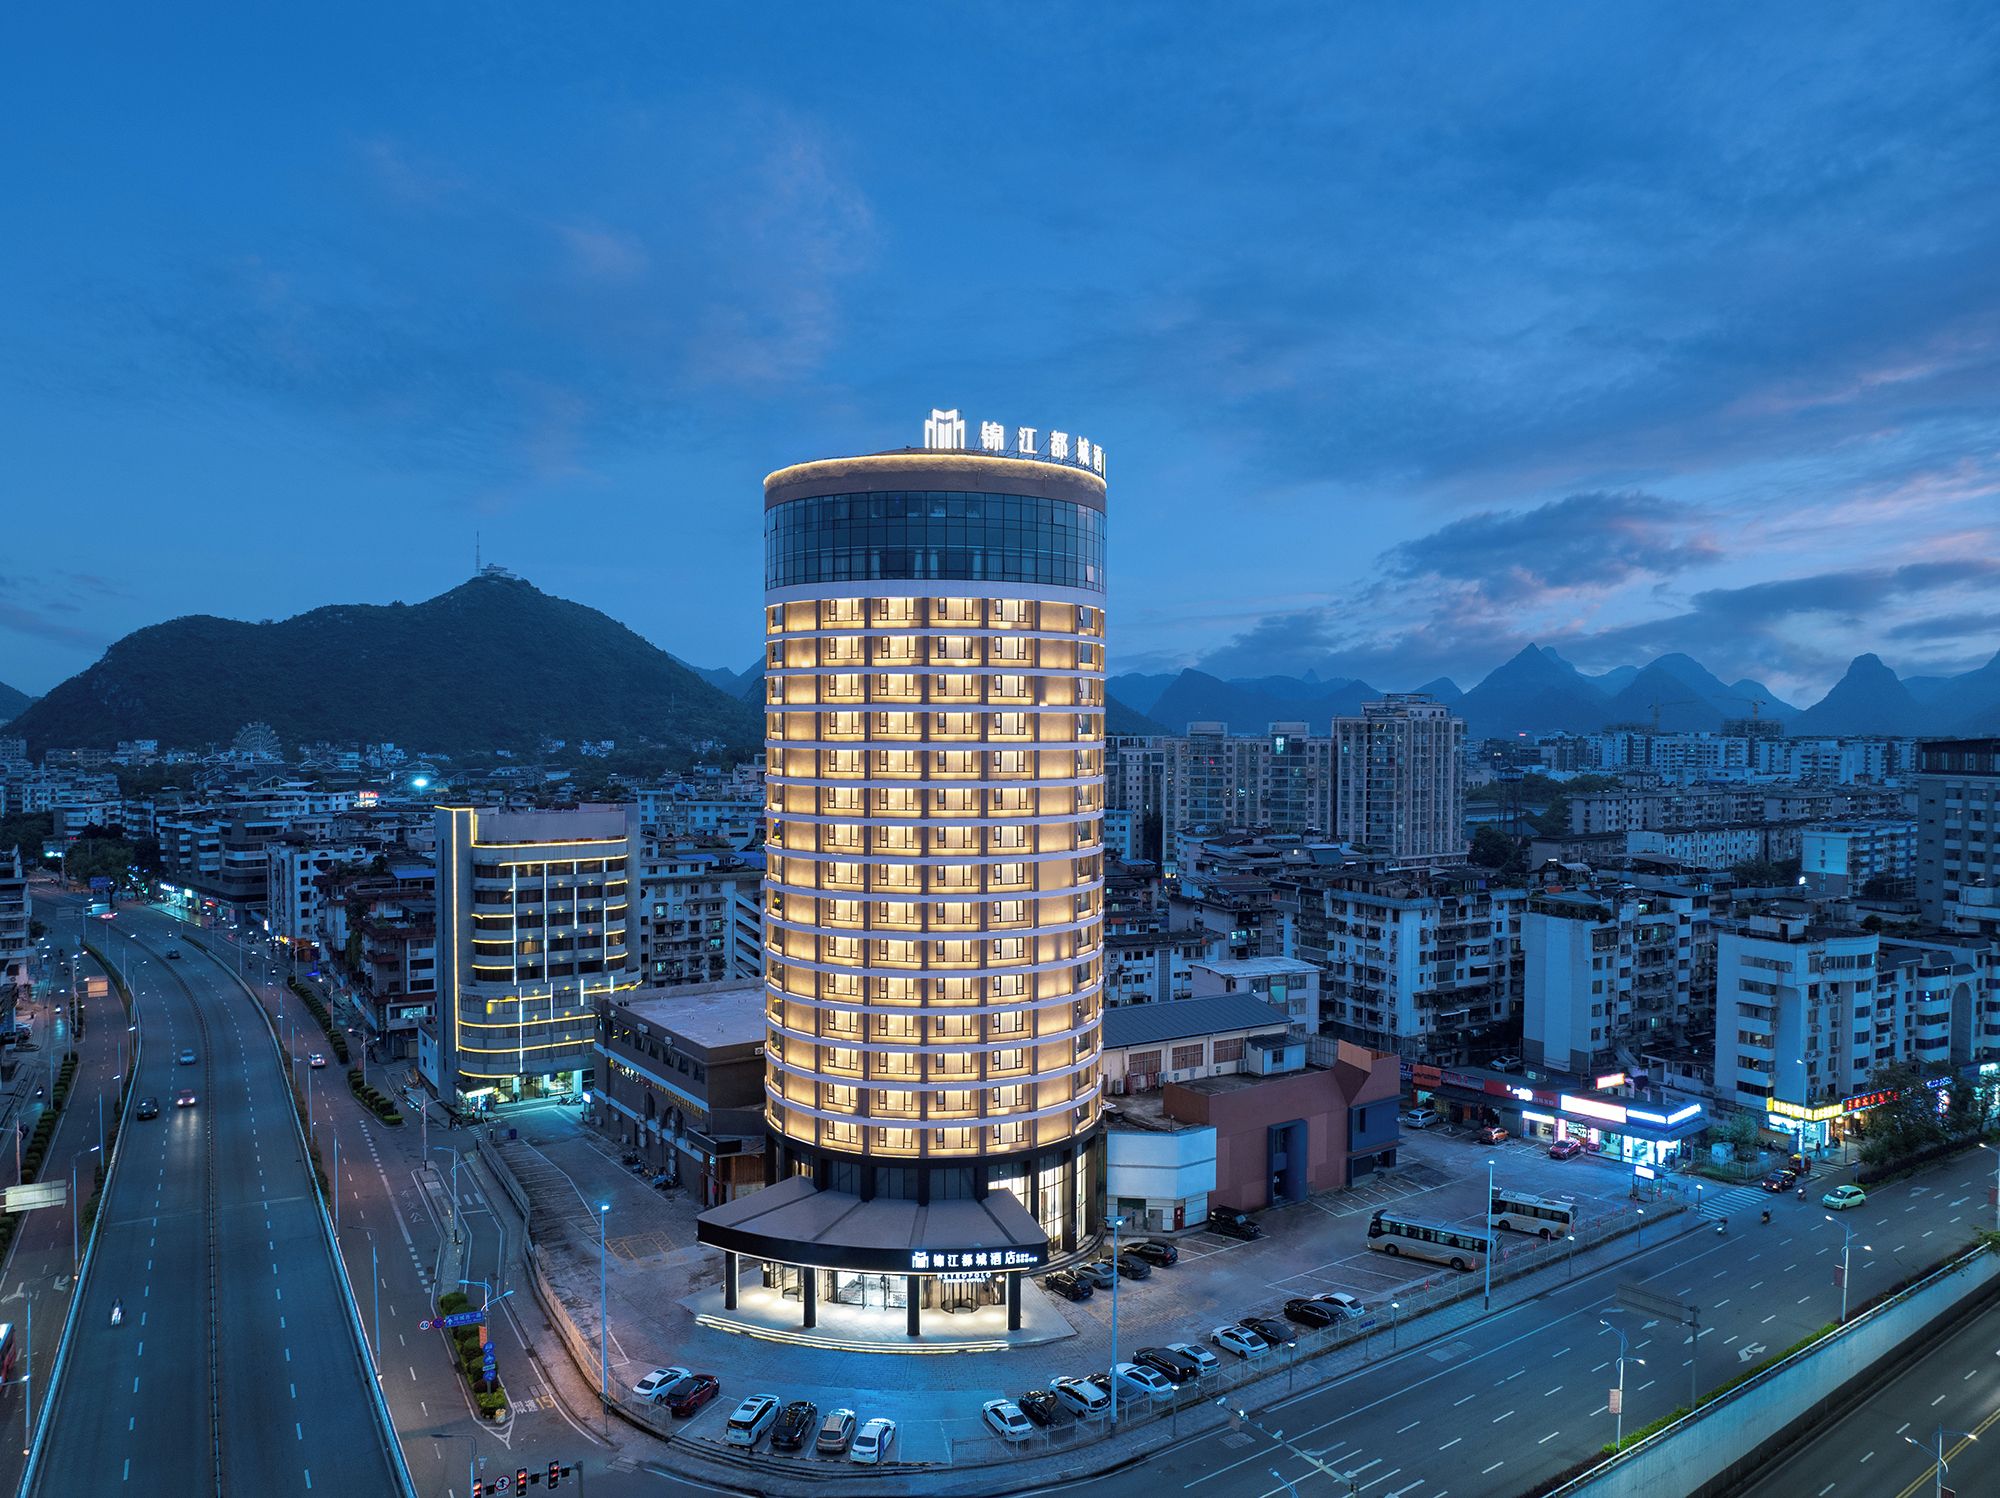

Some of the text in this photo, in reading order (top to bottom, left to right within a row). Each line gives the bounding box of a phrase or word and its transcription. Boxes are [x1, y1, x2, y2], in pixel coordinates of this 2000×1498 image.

[981, 421, 1106, 479] 锦江都城酒
[933, 1251, 1016, 1267] 锦江都城酒店
[420, 1321, 429, 1330] 40
